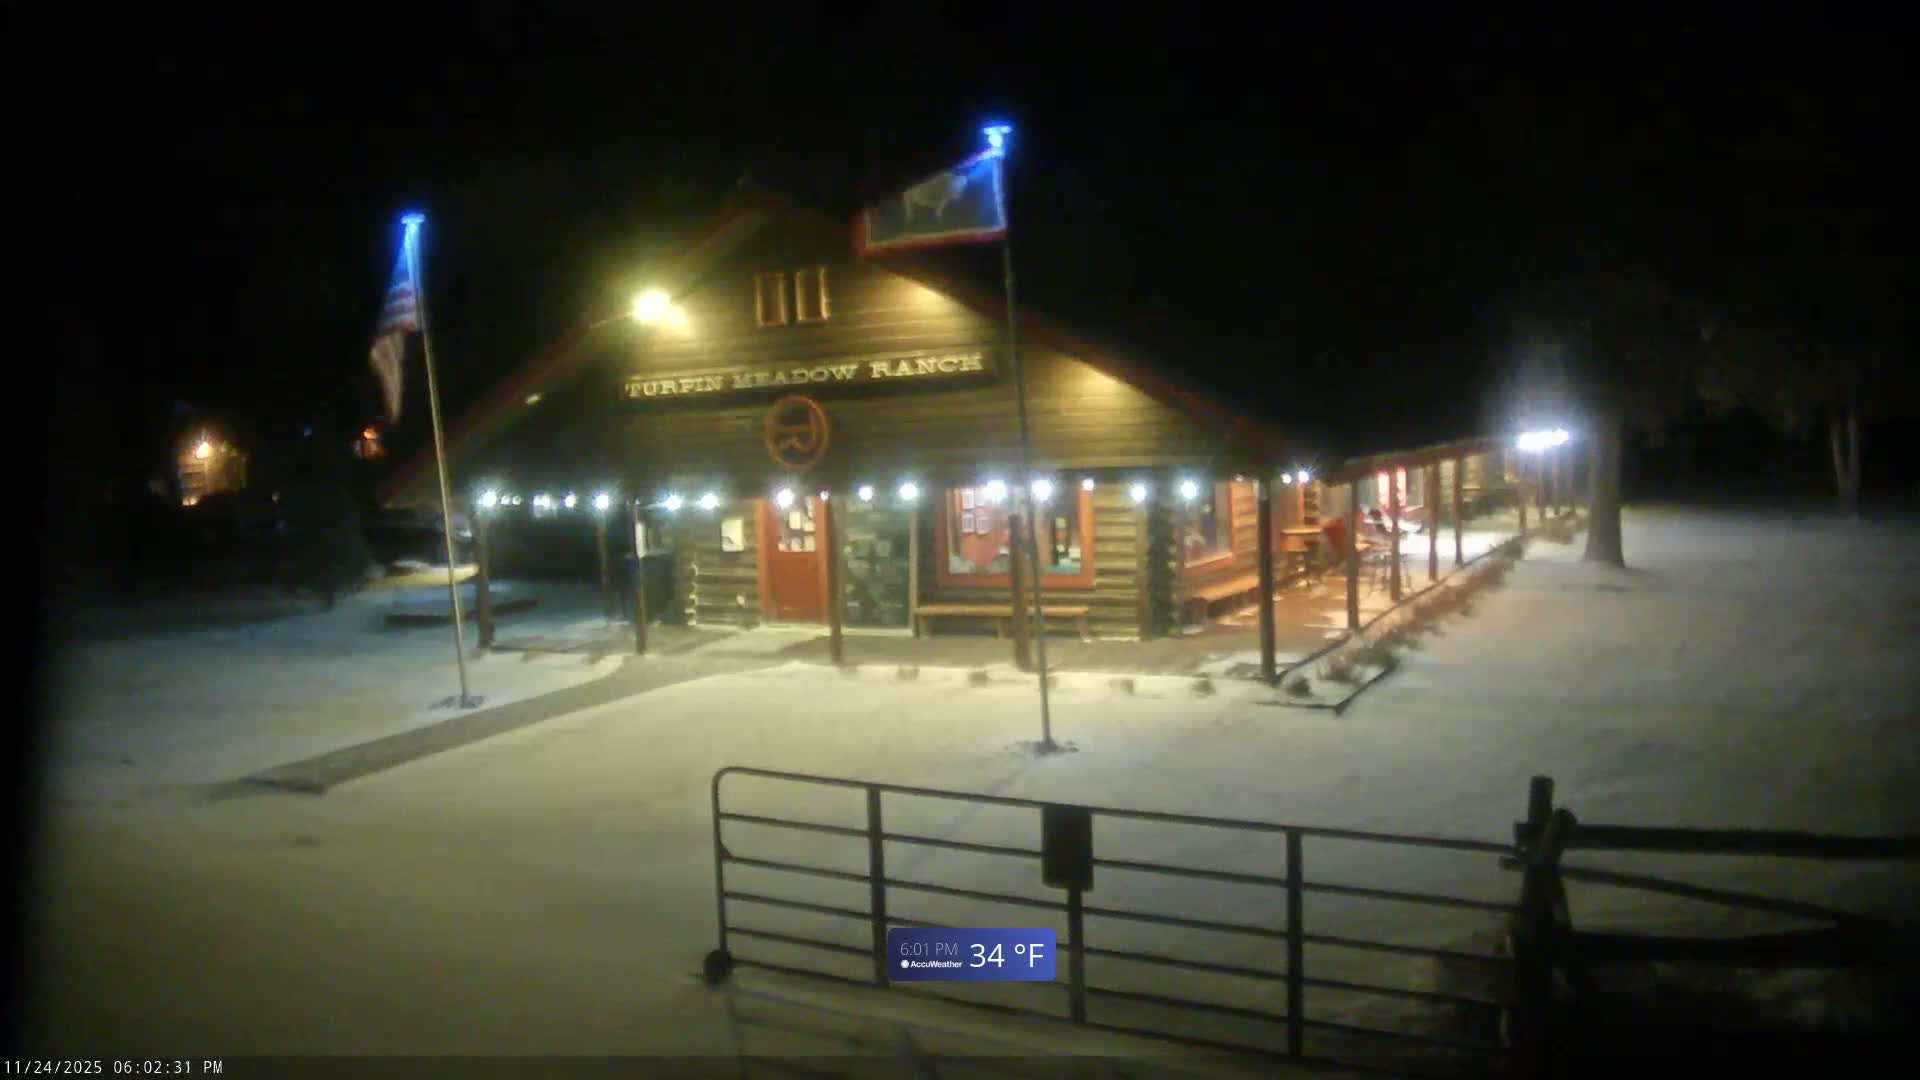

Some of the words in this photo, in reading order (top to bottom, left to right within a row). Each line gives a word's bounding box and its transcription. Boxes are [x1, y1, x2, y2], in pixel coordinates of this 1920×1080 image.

[625, 374, 723, 397] TURPIN
[732, 363, 858, 389] MEADOW
[868, 352, 984, 379] RANCH
